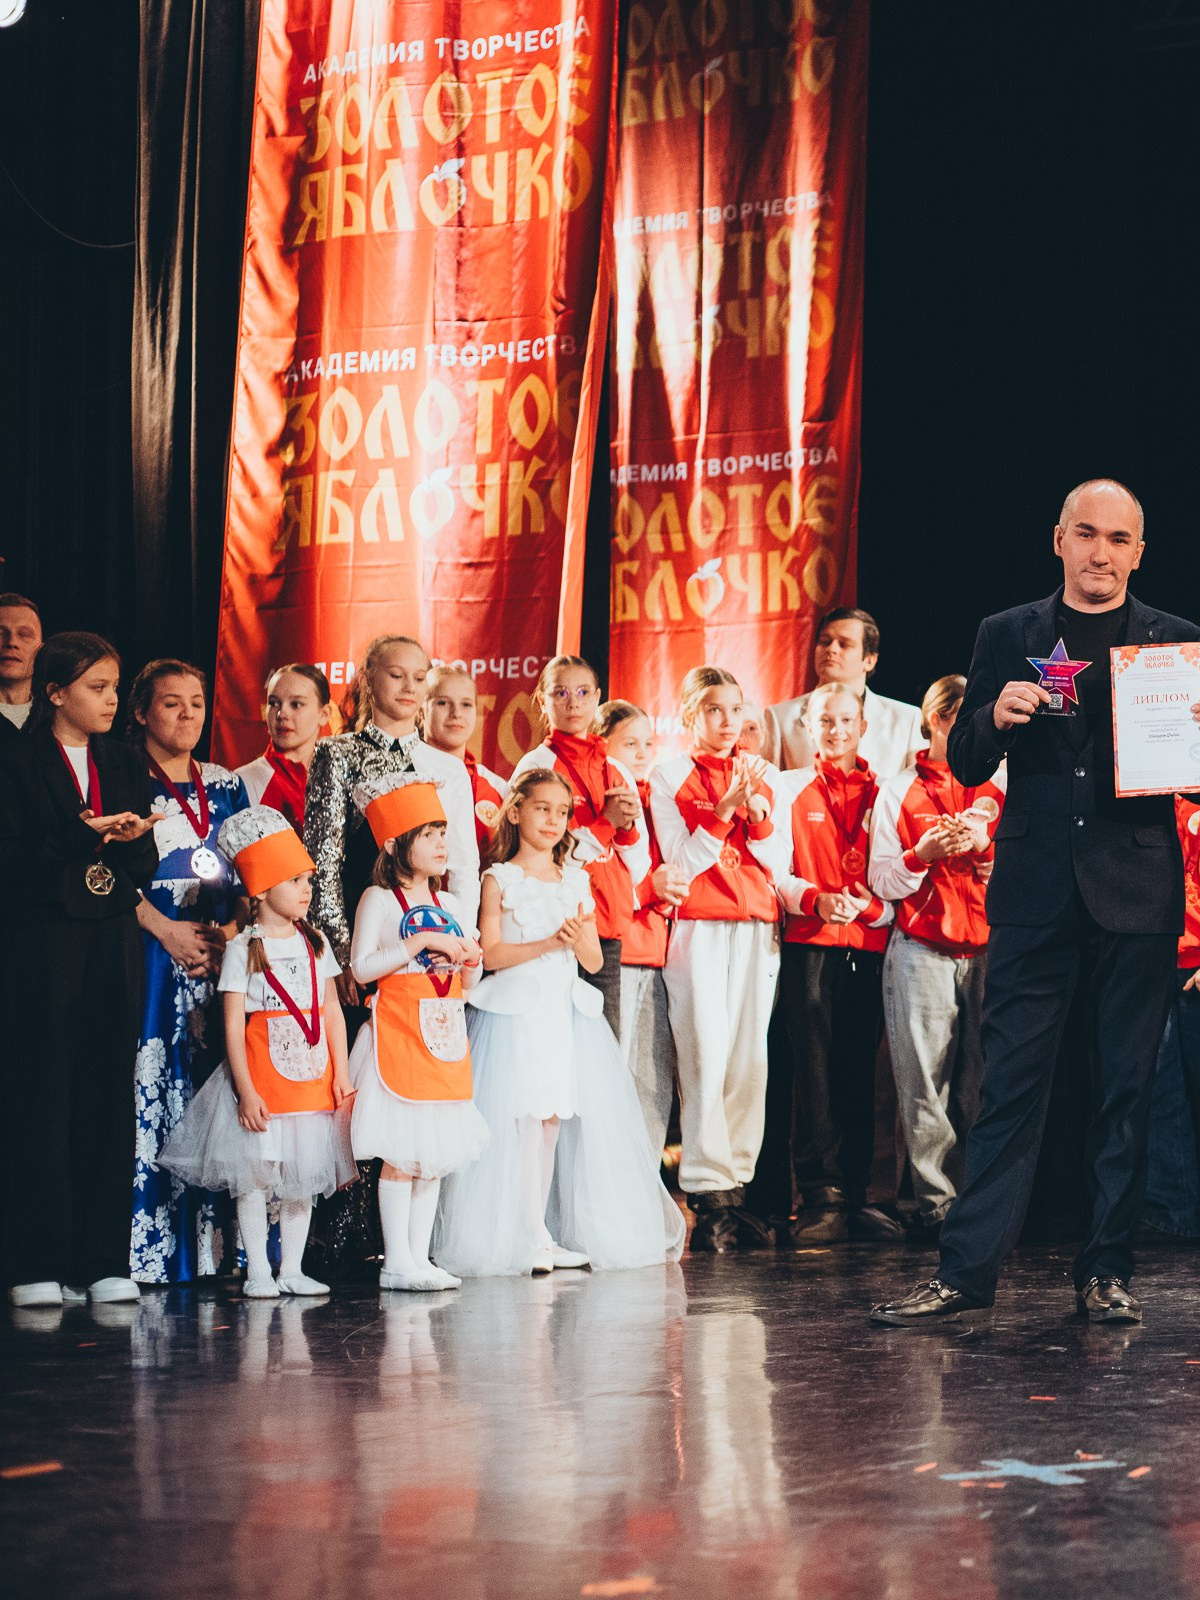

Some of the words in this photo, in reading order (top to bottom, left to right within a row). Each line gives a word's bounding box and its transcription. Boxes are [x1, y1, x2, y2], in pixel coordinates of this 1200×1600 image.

[303, 40, 424, 84] АКАДЕМИЯ
[434, 15, 590, 60] ТВОРЧЕСТВА
[298, 51, 593, 163] ЗОЛОТОЕ
[293, 136, 593, 245] ЯБЛОЧКО
[284, 346, 416, 383] АКАДЕМИЯ
[423, 334, 582, 368] ТВОРЧЕСТВ
[695, 446, 838, 478] ТВОРЧЕСТВА
[1131, 692, 1191, 706] ДИПЛОМ
